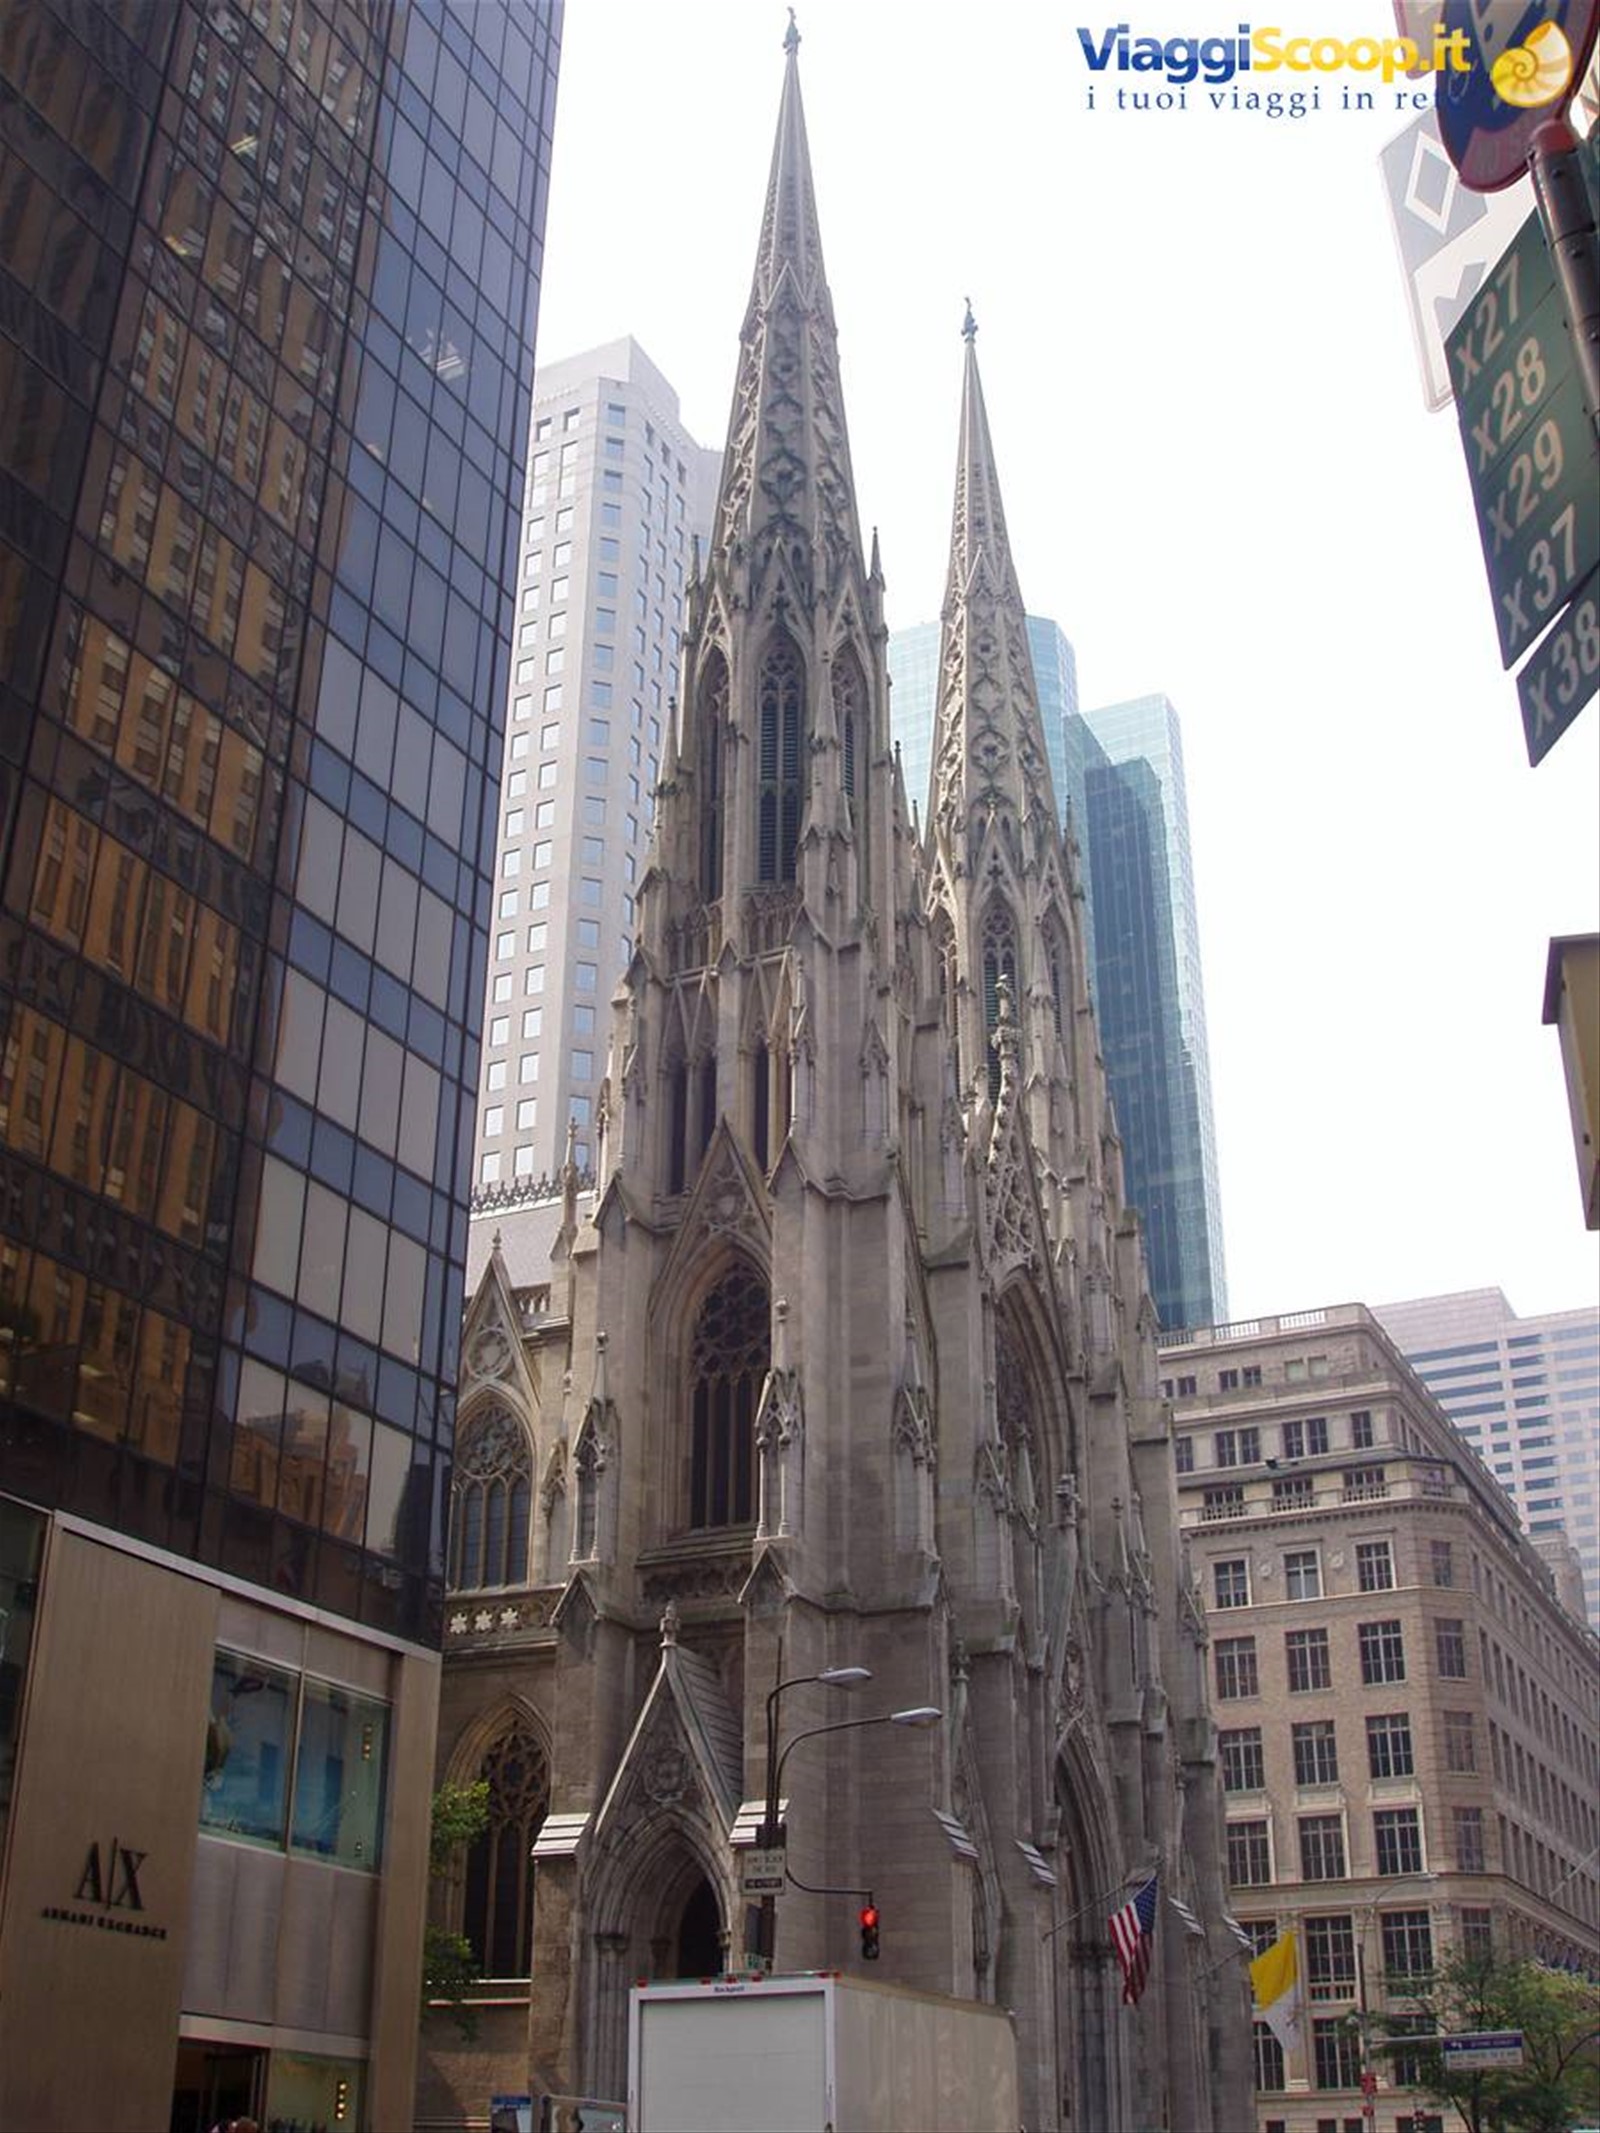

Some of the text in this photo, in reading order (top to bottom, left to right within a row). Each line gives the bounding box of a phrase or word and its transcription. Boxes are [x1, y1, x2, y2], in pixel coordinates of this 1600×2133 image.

[1471, 336, 1547, 473] X28
[1486, 419, 1565, 555] X29
[41, 1906, 167, 1940] ARMANI EXCHANGE
